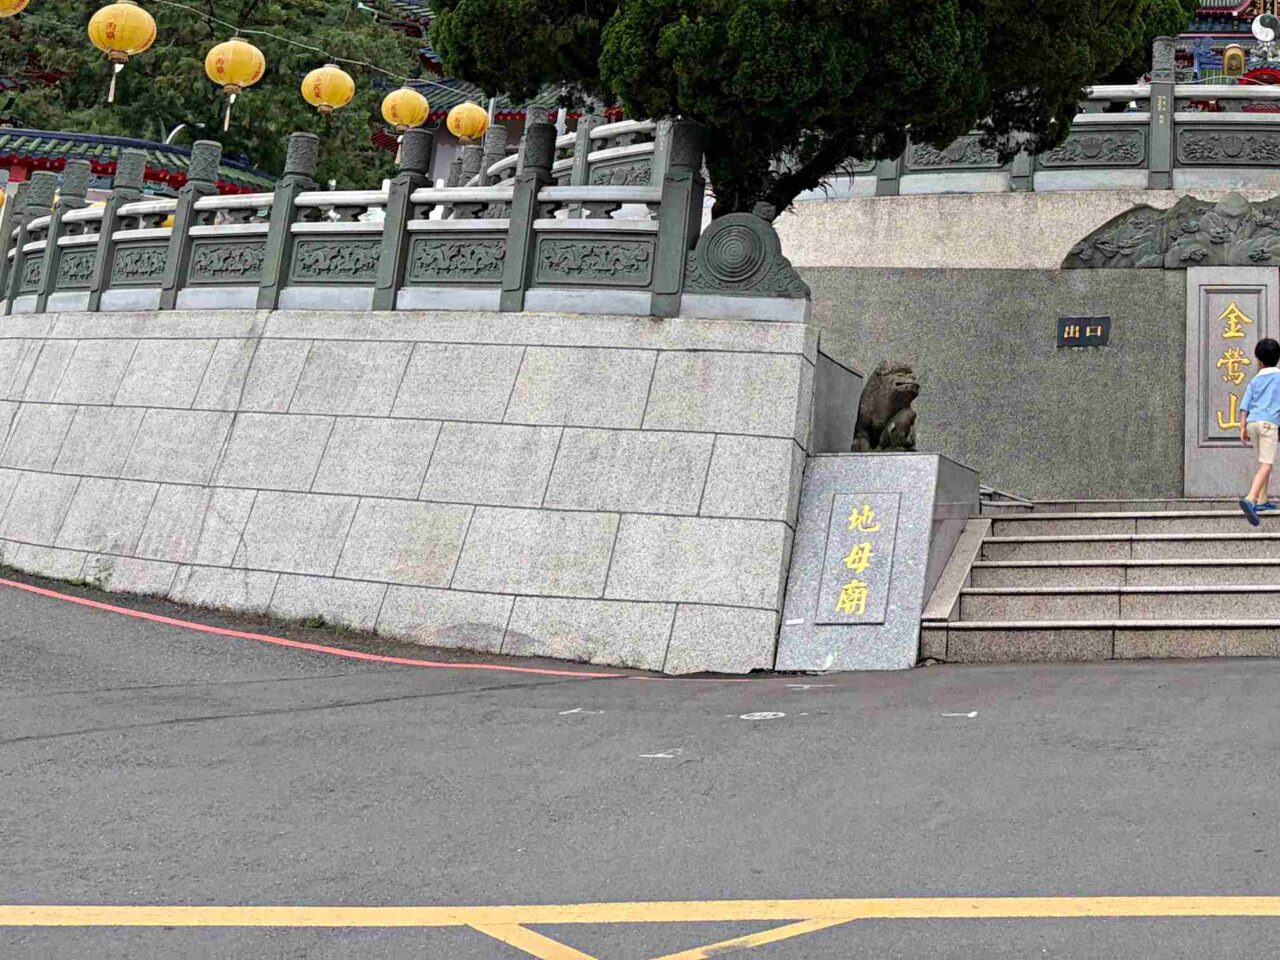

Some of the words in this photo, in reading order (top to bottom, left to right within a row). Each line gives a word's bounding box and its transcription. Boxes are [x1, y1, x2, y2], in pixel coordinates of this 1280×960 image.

[1064, 325, 1102, 339] 出口
[1217, 300, 1254, 430] 金鶯山
[836, 505, 880, 616] 地母廟
